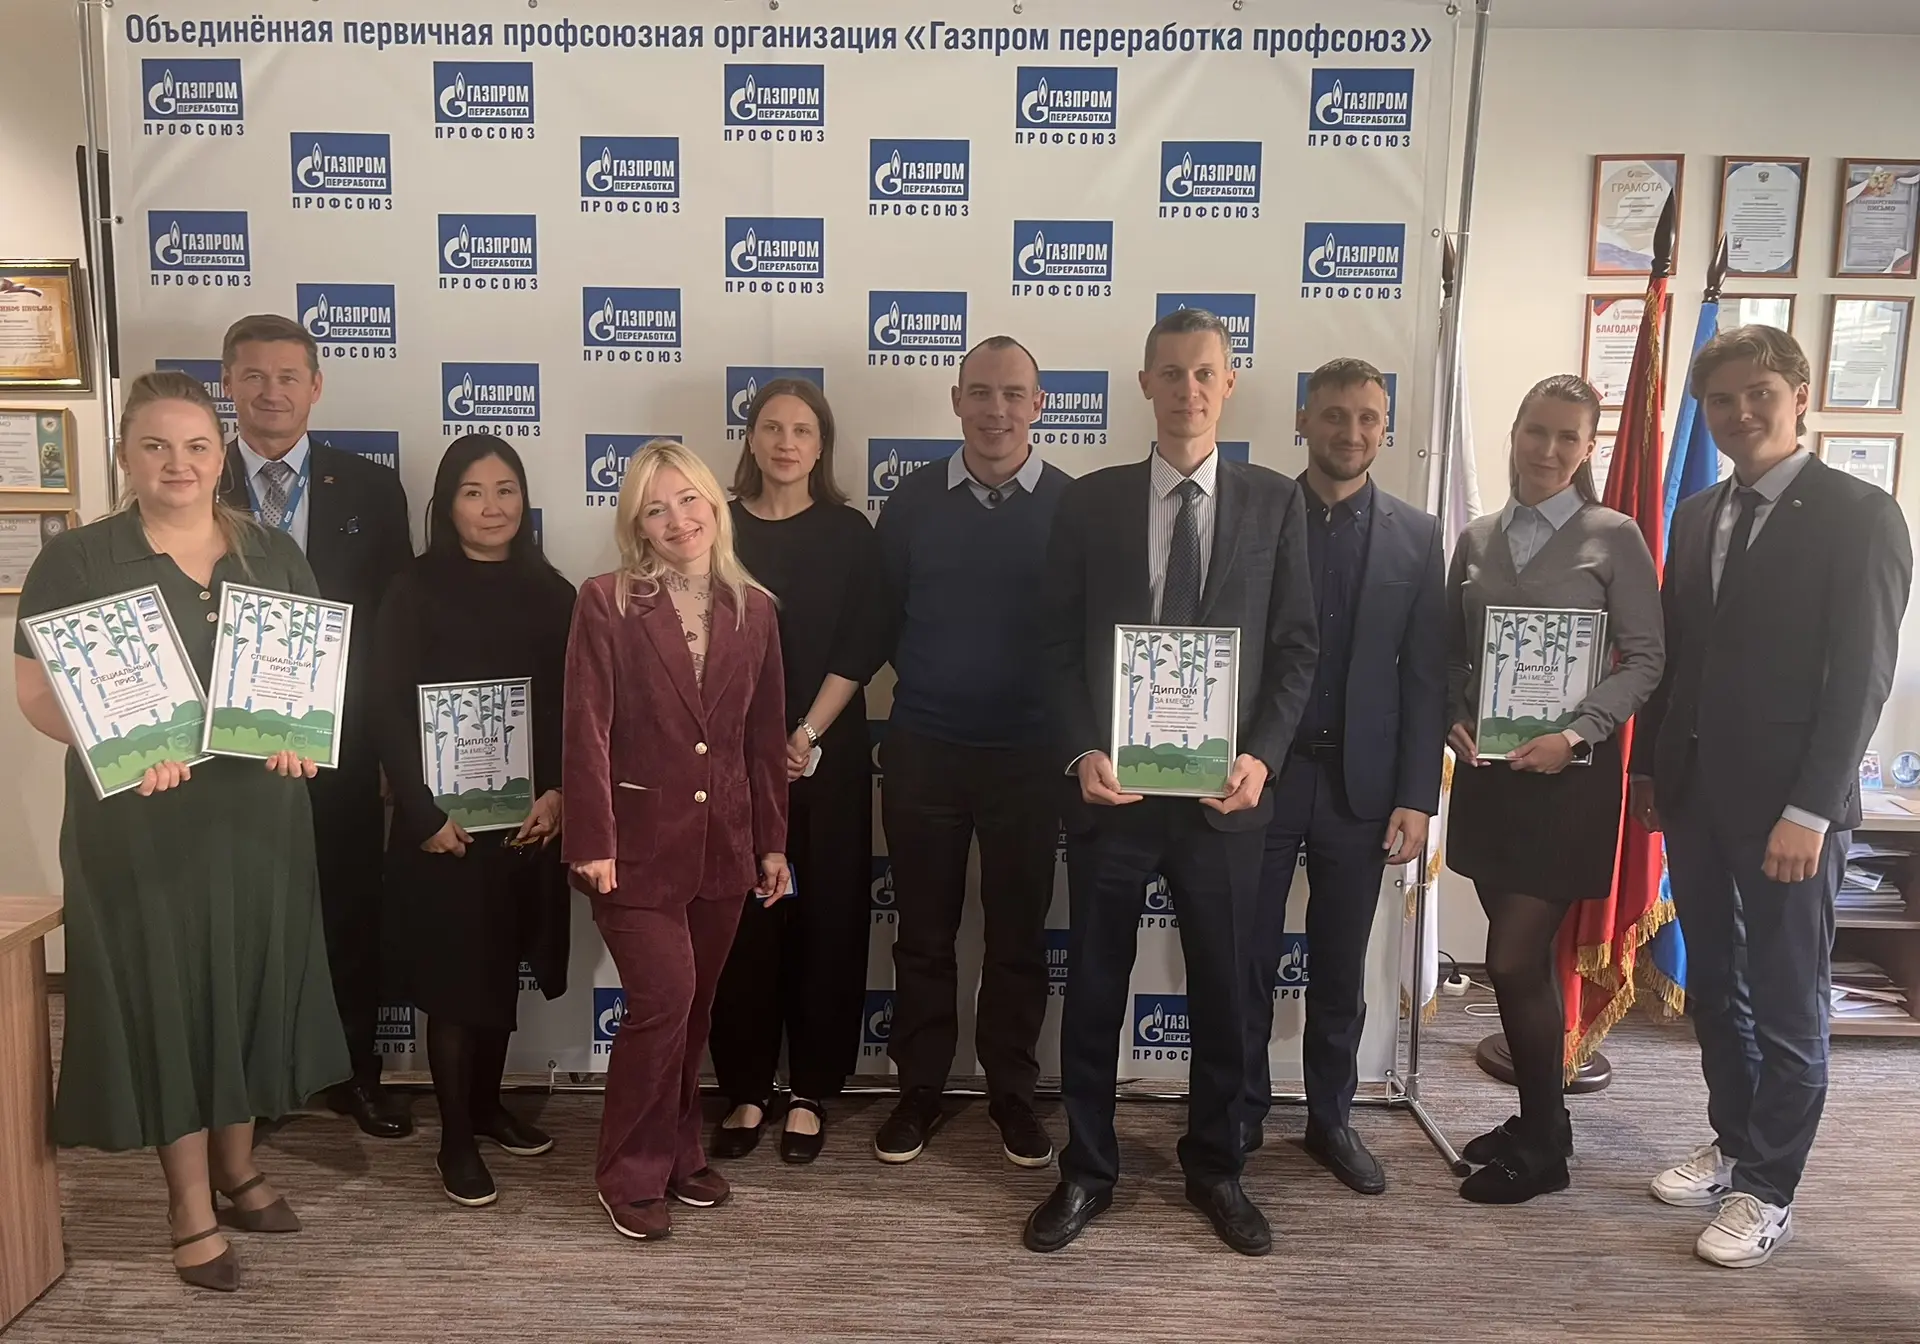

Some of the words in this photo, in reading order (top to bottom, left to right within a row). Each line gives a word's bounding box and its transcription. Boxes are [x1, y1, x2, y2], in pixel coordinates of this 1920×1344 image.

[126, 14, 332, 47] Объединённая
[344, 22, 492, 50] первичная
[504, 18, 703, 52] профсоюзная
[715, 25, 896, 55] организация
[905, 21, 1048, 56] «Газпром
[1060, 22, 1242, 57] переработка
[1254, 22, 1431, 58] профсоюз»
[176, 82, 237, 100] ГАЗПРОМ
[467, 84, 528, 102] ГАЗПРОМ
[758, 87, 819, 106] ГАЗПРОМ
[1051, 90, 1112, 109] ГАЗПРОМ
[1345, 92, 1408, 110] ГАЗПРОМ
[177, 105, 236, 114] ПЕРЕРАБОТКА
[468, 107, 527, 116] ПЕРЕРАБОТКА
[759, 111, 818, 119] ПЕРЕРАБОТКА
[1052, 114, 1110, 122] ПЕРЕРАБОТКА
[1346, 115, 1407, 124] ПЕРЕРАБОТКА
[144, 124, 243, 135] ПРОФСОЮЗ
[436, 127, 534, 139] ПРОФСОЮЗ
[725, 130, 824, 141] ПРОФСОЮЗ
[1016, 132, 1115, 144] ПРОФСОЮЗ
[1309, 135, 1410, 147] ПРОФСОЮЗ
[324, 155, 385, 174] ГАЗПРОМ
[613, 159, 673, 177] ГАЗПРОМ
[903, 162, 964, 180] ГАЗПРОМ
[1194, 164, 1255, 182] ГАЗПРОМ
[325, 179, 384, 187] ПЕРЕРАБОТКА
[614, 182, 672, 191] ПЕРЕРАБОТКА
[1612, 182, 1663, 192] ГРАМОТА
[904, 185, 962, 194] ПЕРЕРАБОТКА
[1195, 187, 1254, 196] ПЕРЕРАБОТКА
[293, 197, 392, 210] ПРОФСОЮЗ
[581, 201, 679, 213] ПРОФСОЮЗ
[870, 204, 968, 216] ПРОФСОЮЗ
[1160, 206, 1259, 218] ПРОФСОЮЗ
[183, 233, 244, 251] ГАЗПРОМ
[471, 236, 531, 254] ГАЗПРОМ
[758, 240, 819, 258] ГАЗПРОМ
[1046, 243, 1107, 261] ГАЗПРОМ
[1337, 245, 1399, 263] ГАЗПРОМ
[184, 256, 242, 265] ПЕРЕРАБОТКА
[472, 259, 530, 268] ПЕРЕРАБОТКА
[759, 263, 818, 272] ПЕРЕРАБОТКА
[1047, 266, 1106, 275] ПЕРЕРАБОТКА
[1338, 268, 1398, 277] ПЕРЕРАБОТКА
[151, 274, 251, 286] ПРОФСОЮЗ
[440, 278, 537, 289] ПРОФСОЮЗ
[726, 281, 823, 293] ПРОФСОЮЗ
[1012, 285, 1111, 296] ПРОФСОЮЗ
[1302, 287, 1401, 299] ПРОФСОЮЗ
[330, 305, 390, 323] ГАЗПРОМ
[616, 310, 676, 328] ГАЗПРОМ
[902, 313, 961, 331] ГАЗПРОМ
[331, 328, 389, 337] ПЕРЕРАБОТКА
[617, 333, 675, 341] ПЕРЕРАБОТКА
[902, 336, 960, 345] ПЕРЕРАБОТКА
[322, 346, 397, 358] ОФСОЮЗ
[584, 350, 681, 362] ПРОФСОЮЗ
[475, 384, 534, 402] ГАЗПРОМ
[475, 407, 533, 415] ПЕРЕРАБОТКА
[1043, 414, 1101, 423] ПЕРЕРАБОТКА
[443, 424, 540, 436] ПРОФСОЮЗ
[1033, 433, 1107, 444] ОФСОЮЗ
[250, 653, 312, 668] СПЕЦИАЛЬНЫЙ
[90, 661, 152, 685] СПЕЦИАЛЬНЫЙ
[270, 664, 292, 673] ПРИЗ
[1516, 662, 1559, 672] Диплом
[114, 675, 136, 687] ПРИЗ
[1152, 684, 1197, 695] Диплом
[457, 736, 498, 748] Диплом
[1133, 1049, 1189, 1061] ПРОФС
